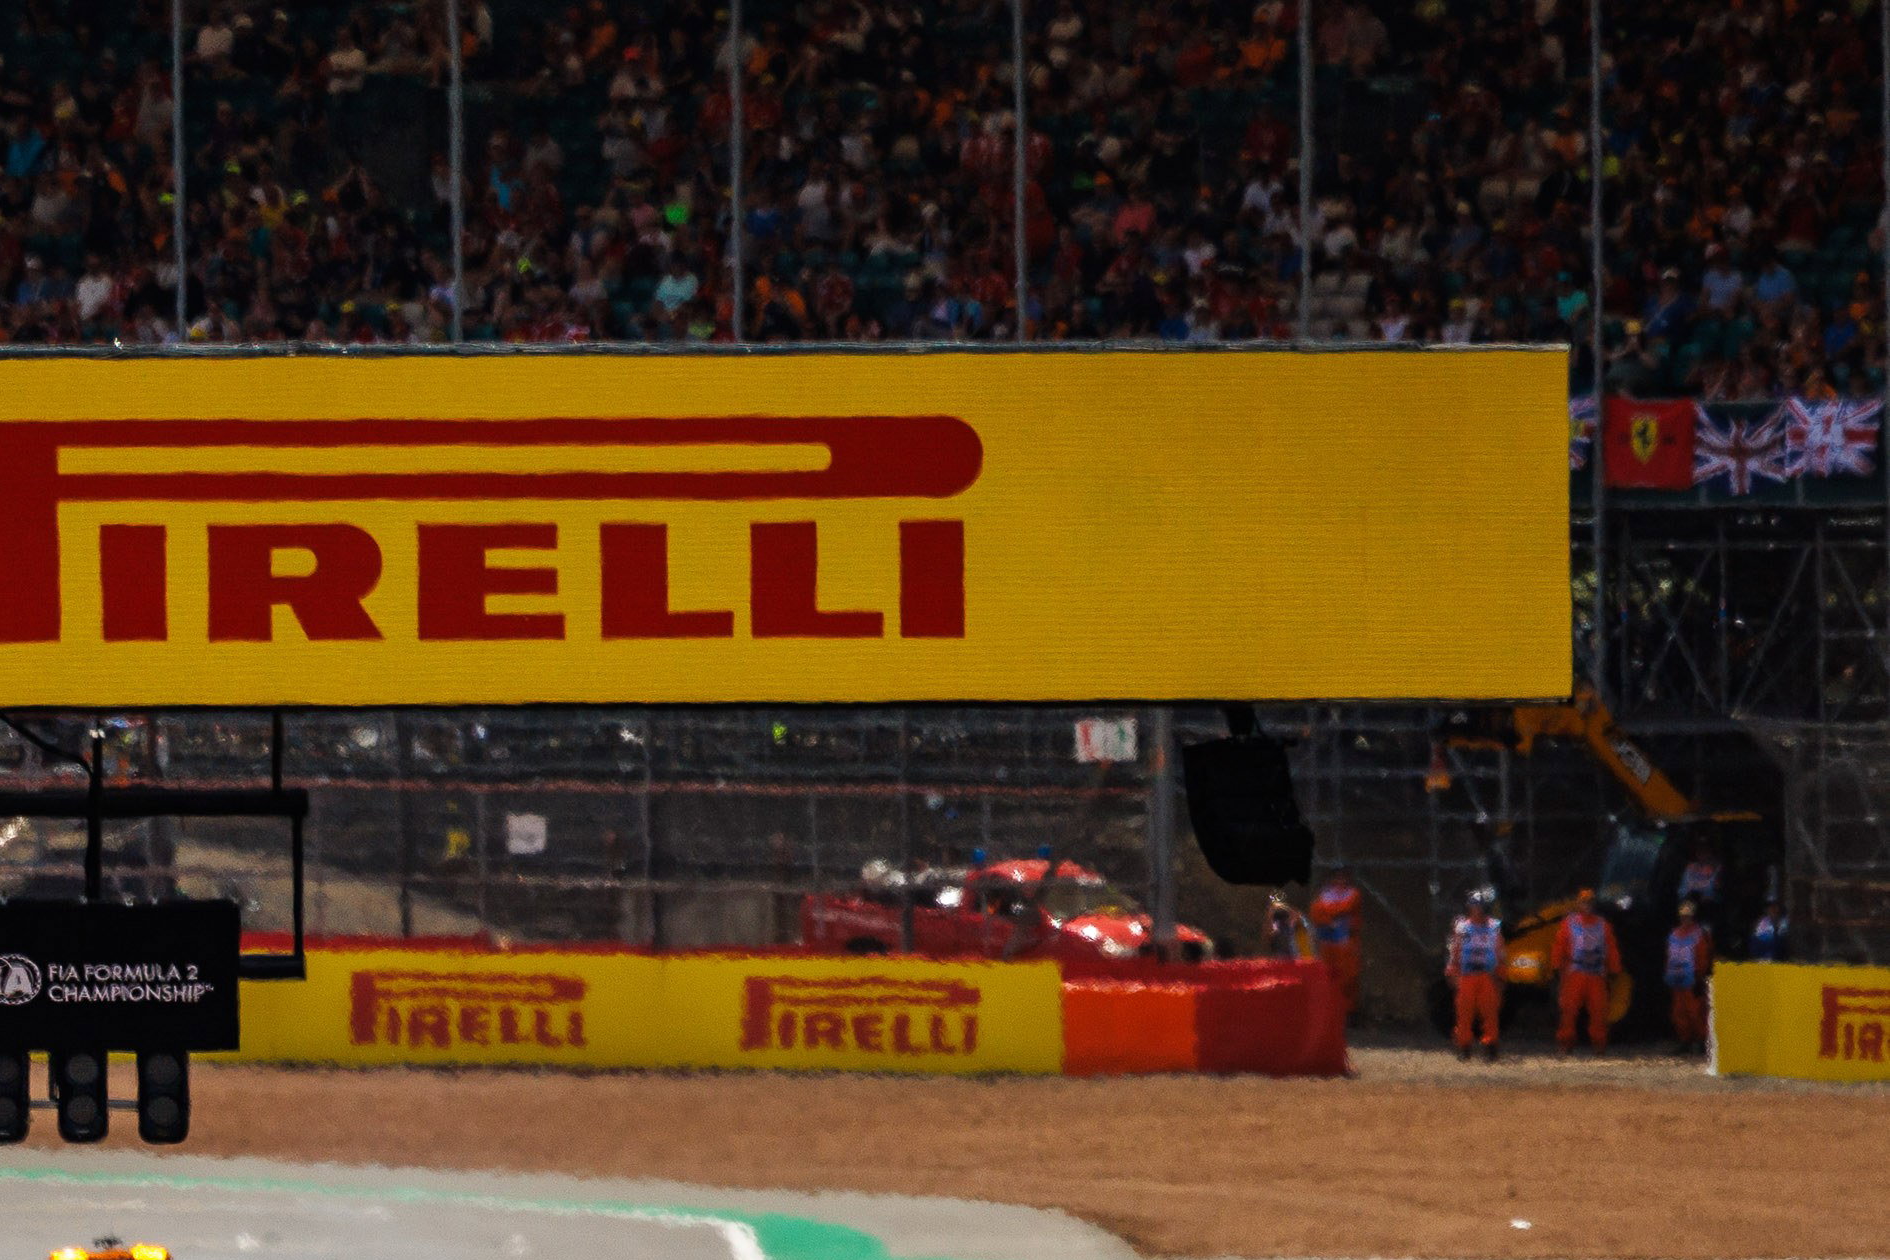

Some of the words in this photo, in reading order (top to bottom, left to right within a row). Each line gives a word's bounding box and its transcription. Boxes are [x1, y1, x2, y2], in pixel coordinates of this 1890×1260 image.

[48, 963, 77, 982] FIA
[84, 963, 181, 982] FORMULA
[186, 964, 198, 981] 2
[349, 970, 589, 1048] PIRELLI
[740, 975, 981, 1055] PIRELLI
